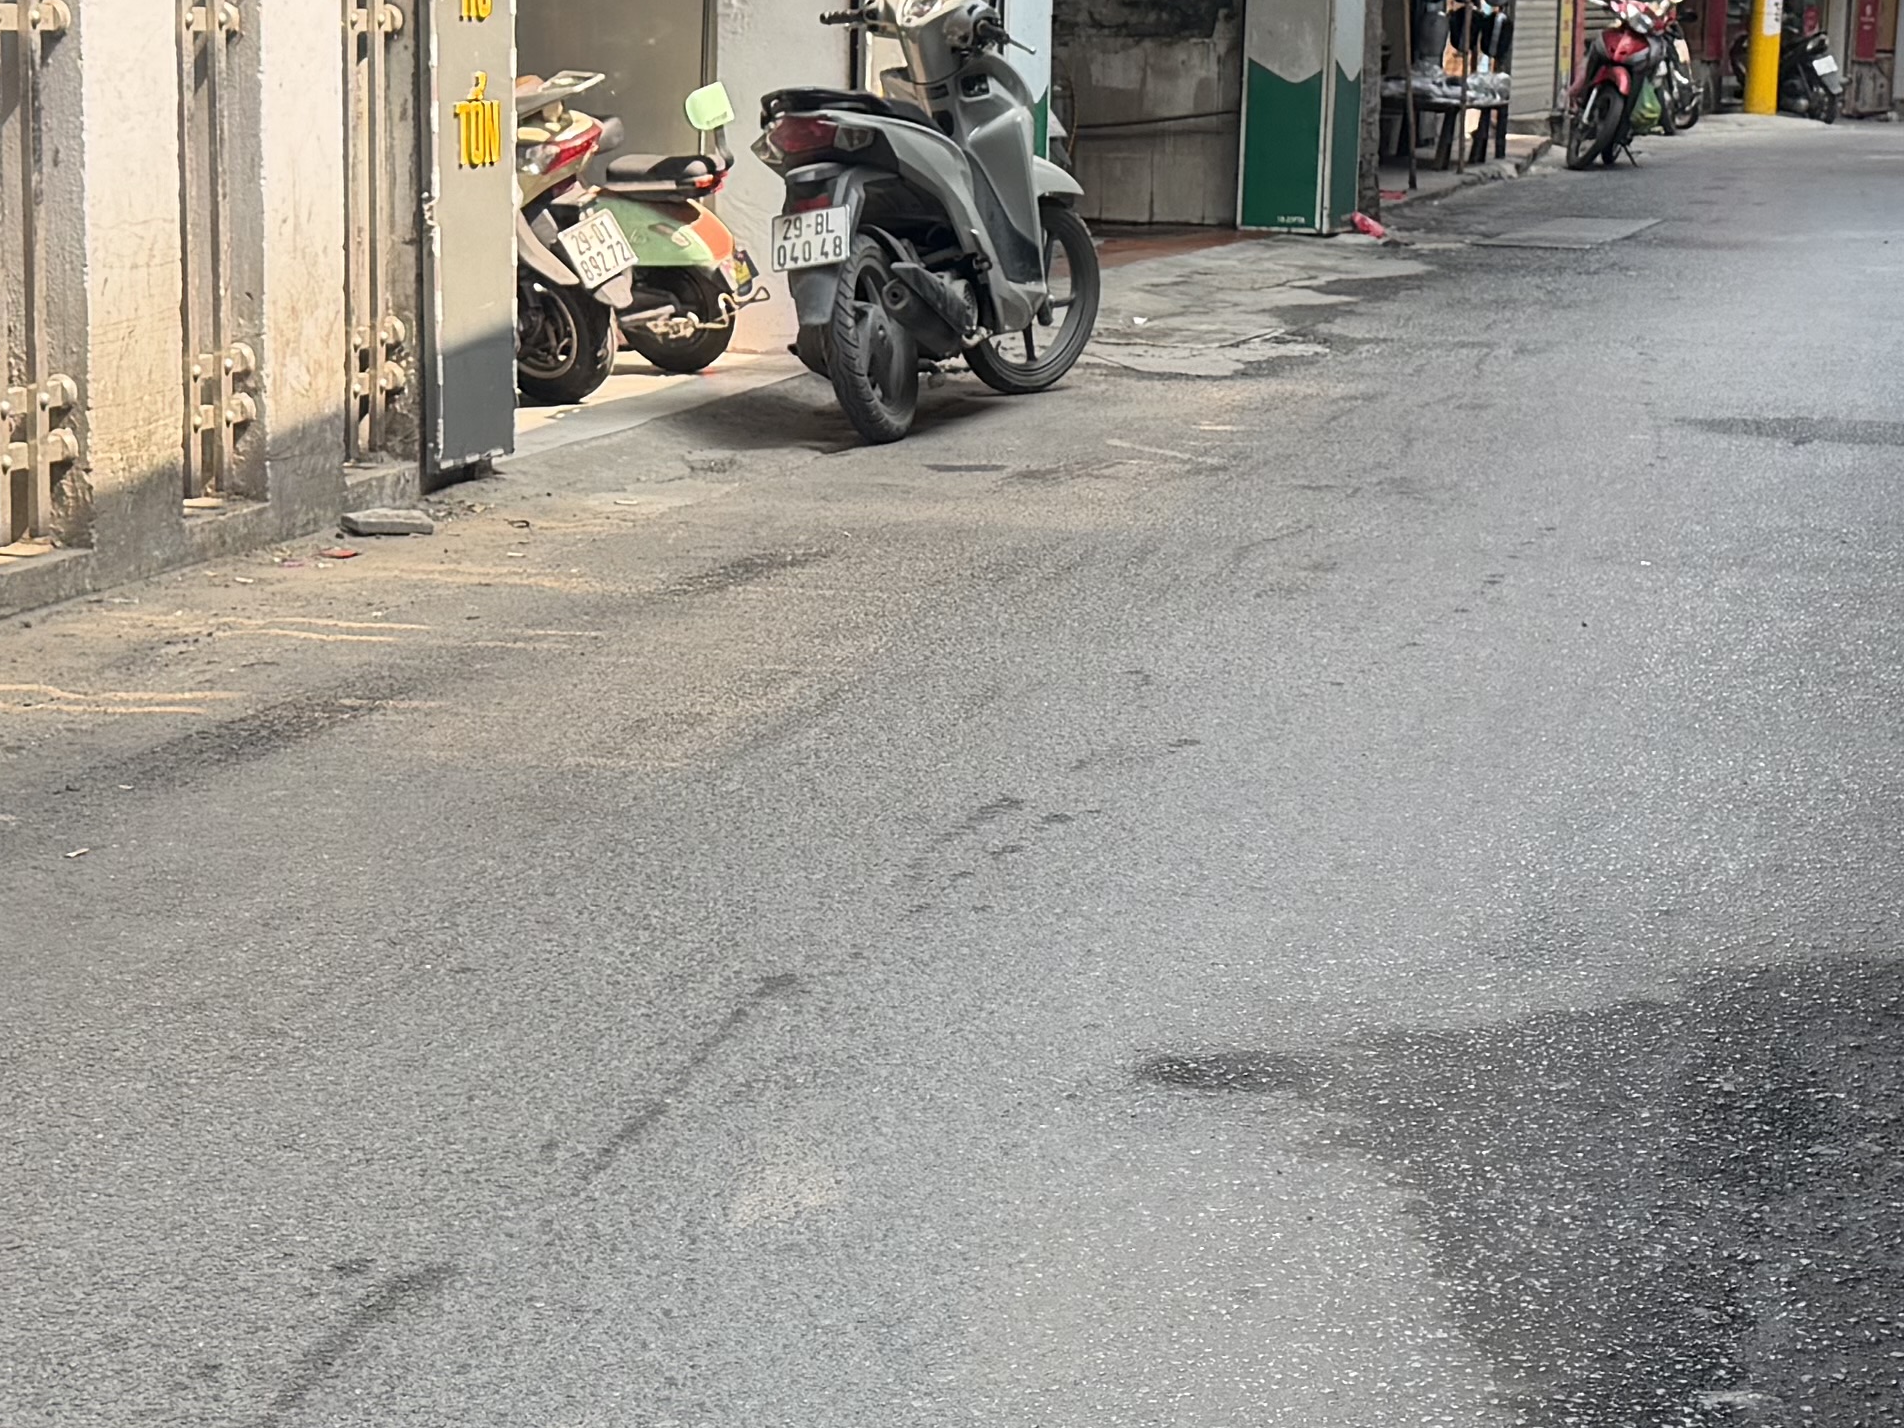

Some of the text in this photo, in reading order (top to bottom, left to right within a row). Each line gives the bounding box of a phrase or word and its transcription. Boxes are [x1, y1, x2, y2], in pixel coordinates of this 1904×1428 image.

[783, 211, 835, 241] 29-BL
[580, 240, 631, 282] 892.72
[777, 235, 843, 268] 040.48
